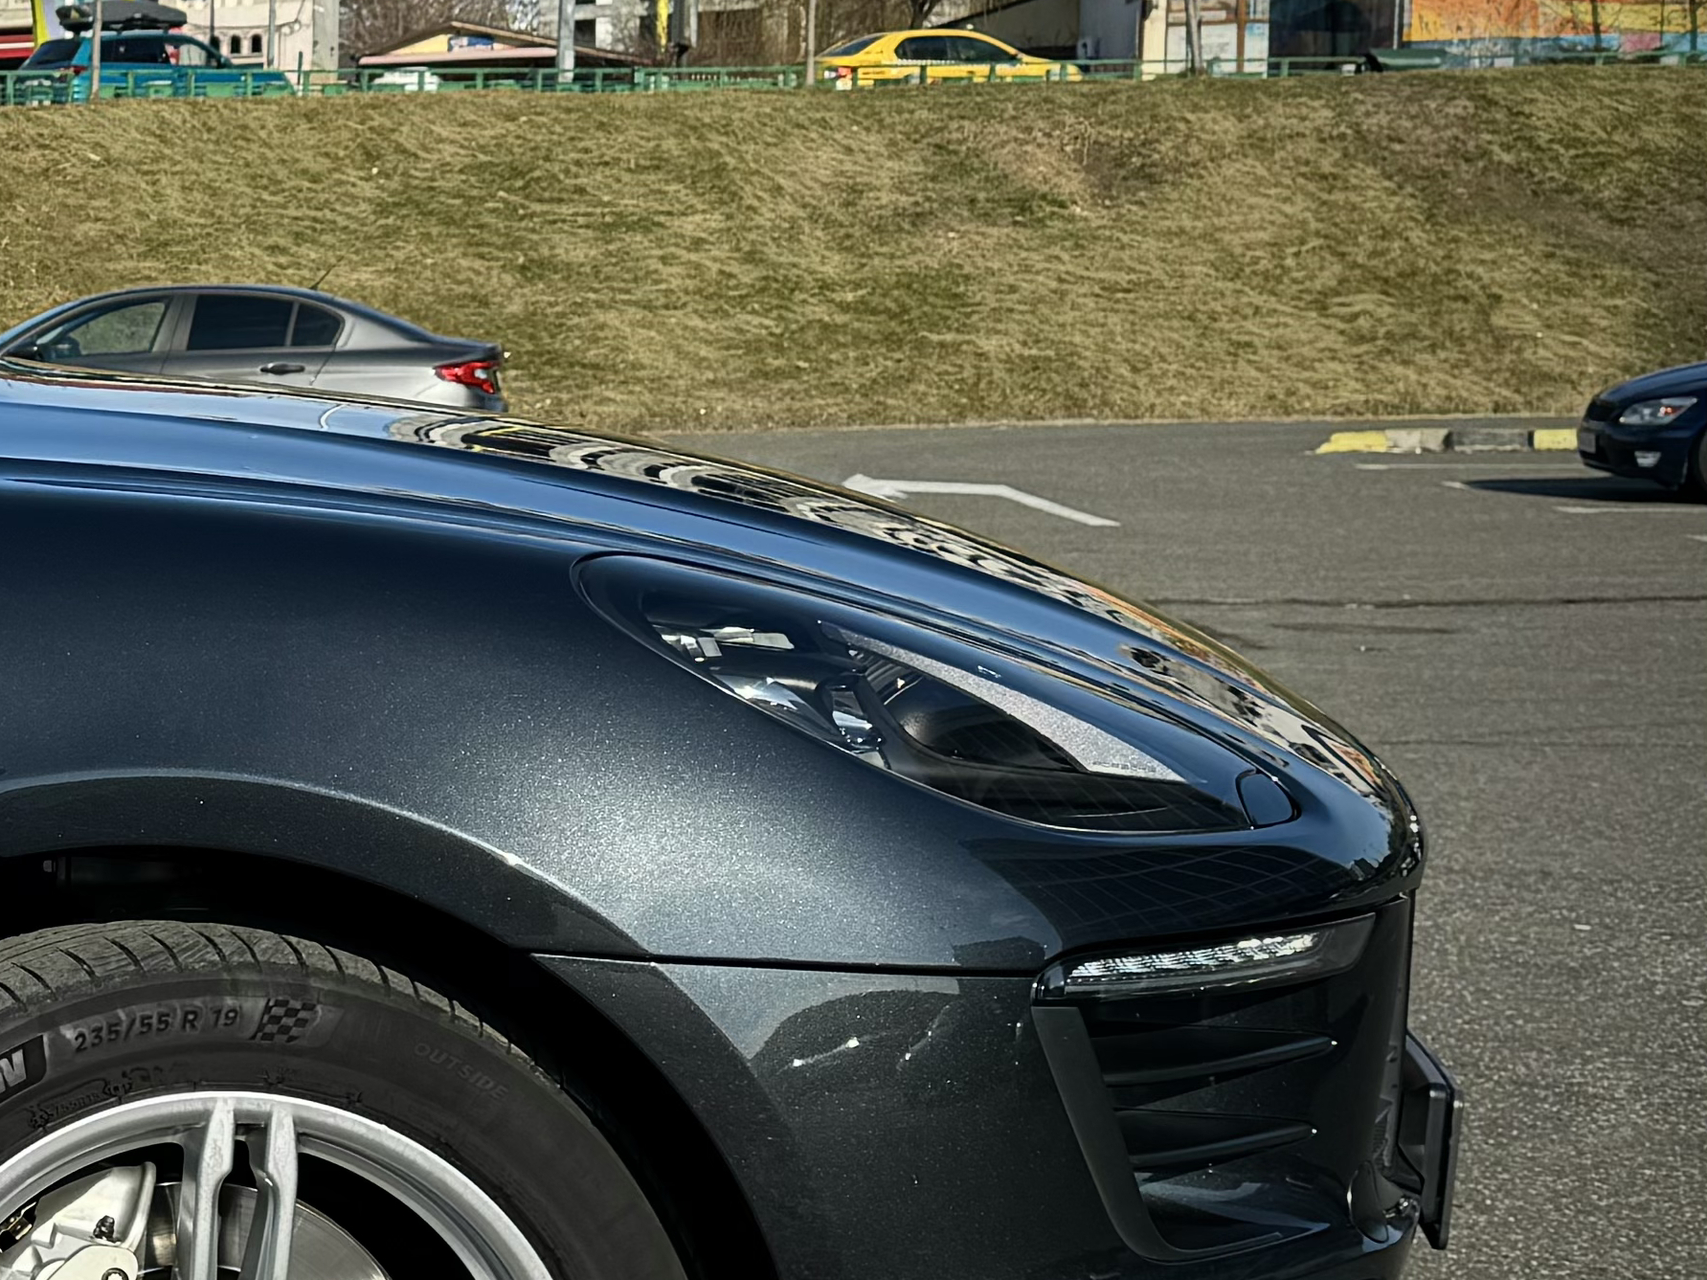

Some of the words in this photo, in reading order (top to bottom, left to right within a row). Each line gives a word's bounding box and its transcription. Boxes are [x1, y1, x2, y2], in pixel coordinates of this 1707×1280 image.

[73, 1010, 171, 1053] 235/55
[181, 1008, 199, 1032] R
[211, 1007, 240, 1030] 19
[414, 1042, 509, 1100] OUTSIDE
